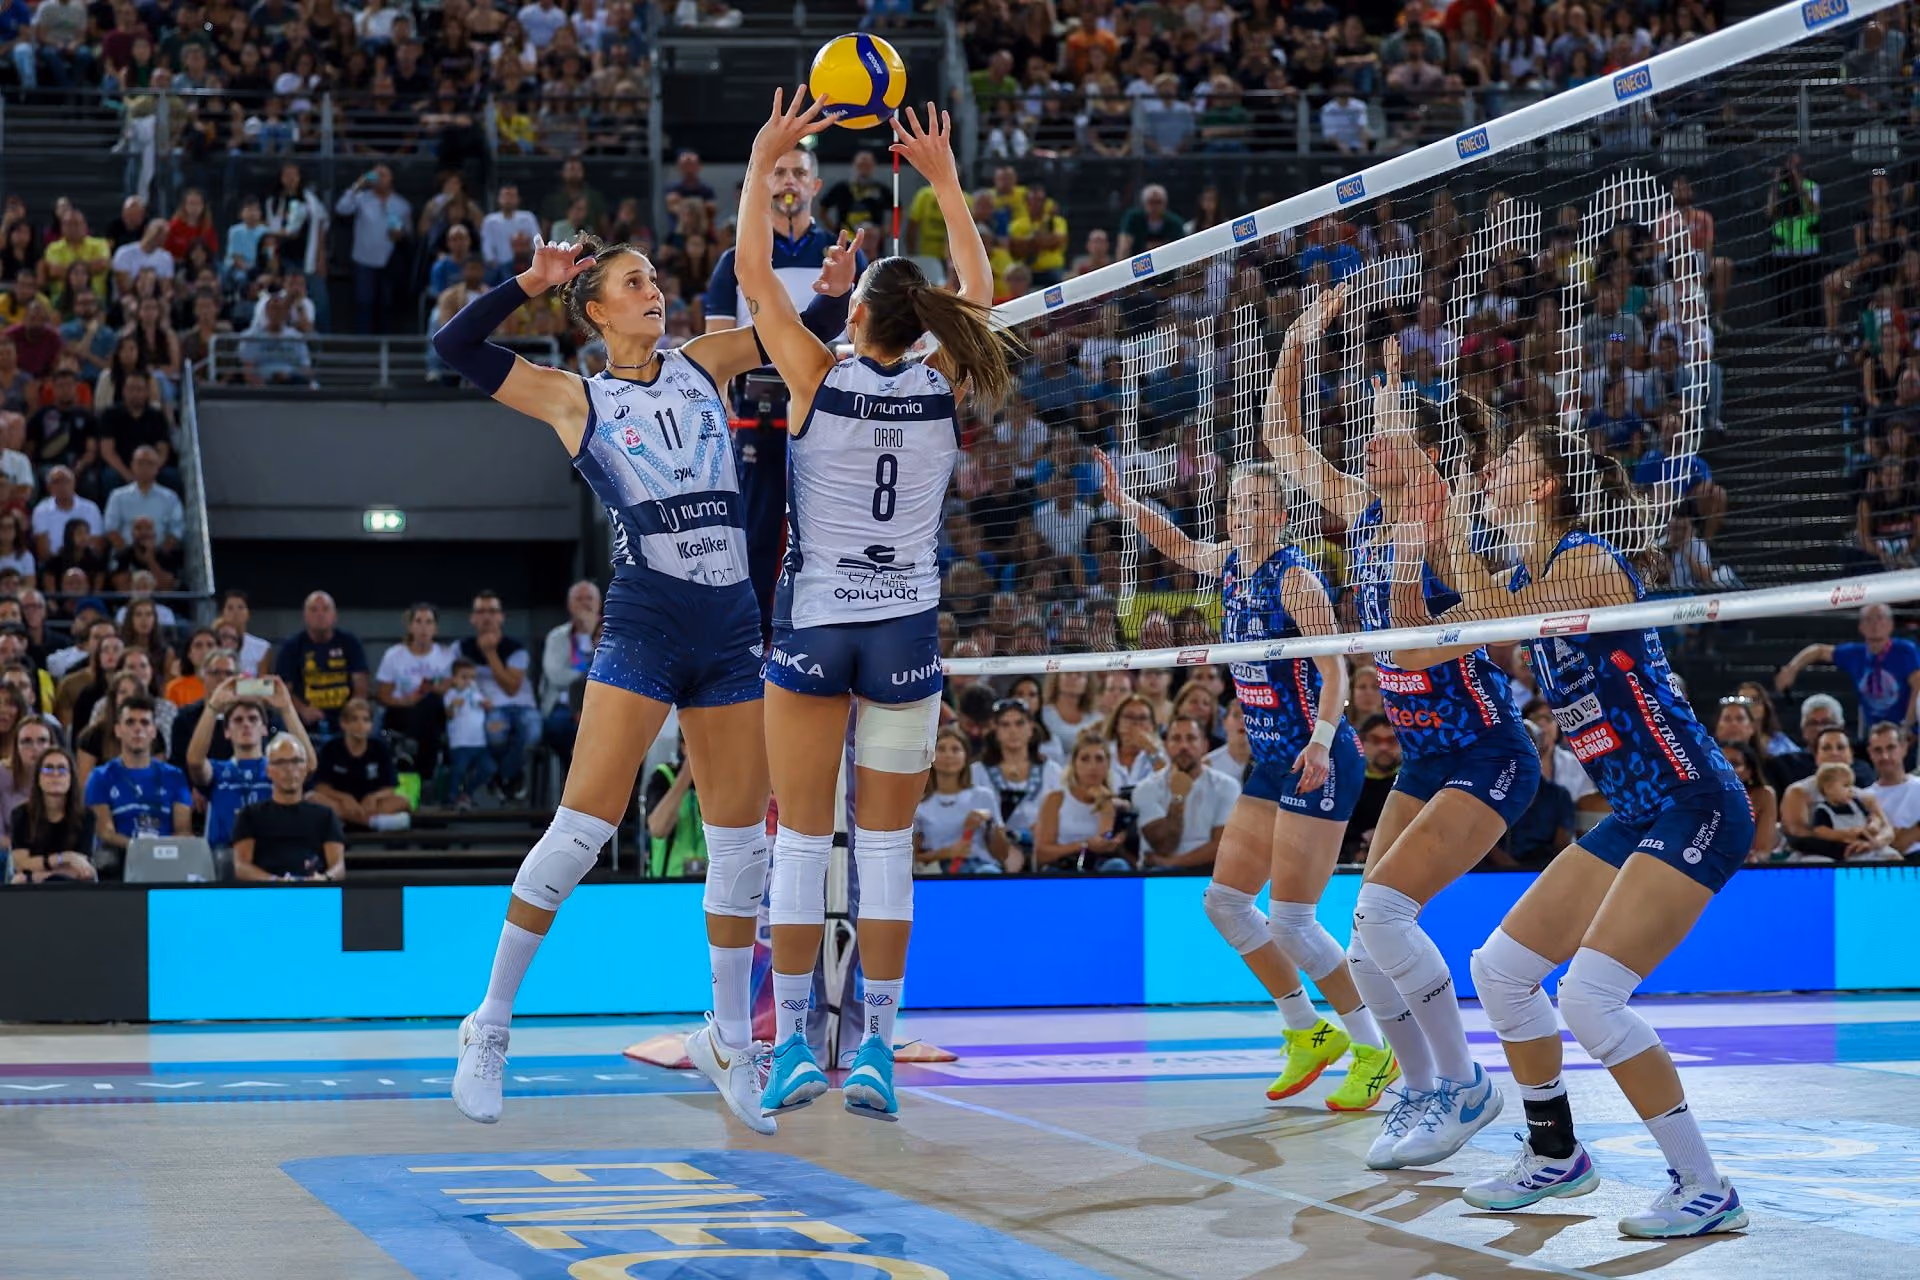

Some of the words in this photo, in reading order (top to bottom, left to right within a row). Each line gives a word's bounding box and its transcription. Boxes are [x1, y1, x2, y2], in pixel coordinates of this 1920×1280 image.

[1805, 0, 1846, 25] FINECO
[1617, 71, 1650, 96] FINECO
[1459, 133, 1487, 155] FINECO
[1339, 179, 1363, 201] FINECO
[1235, 220, 1255, 238] FINECO
[874, 400, 923, 415] numia
[654, 408, 683, 450] 11
[874, 428, 903, 448] ORRO
[872, 453, 899, 522] 8
[834, 587, 919, 603] opiquad
[881, 579, 911, 589] HOTEL
[772, 647, 825, 679] UNIKA
[1659, 724, 1701, 781] TRADING
